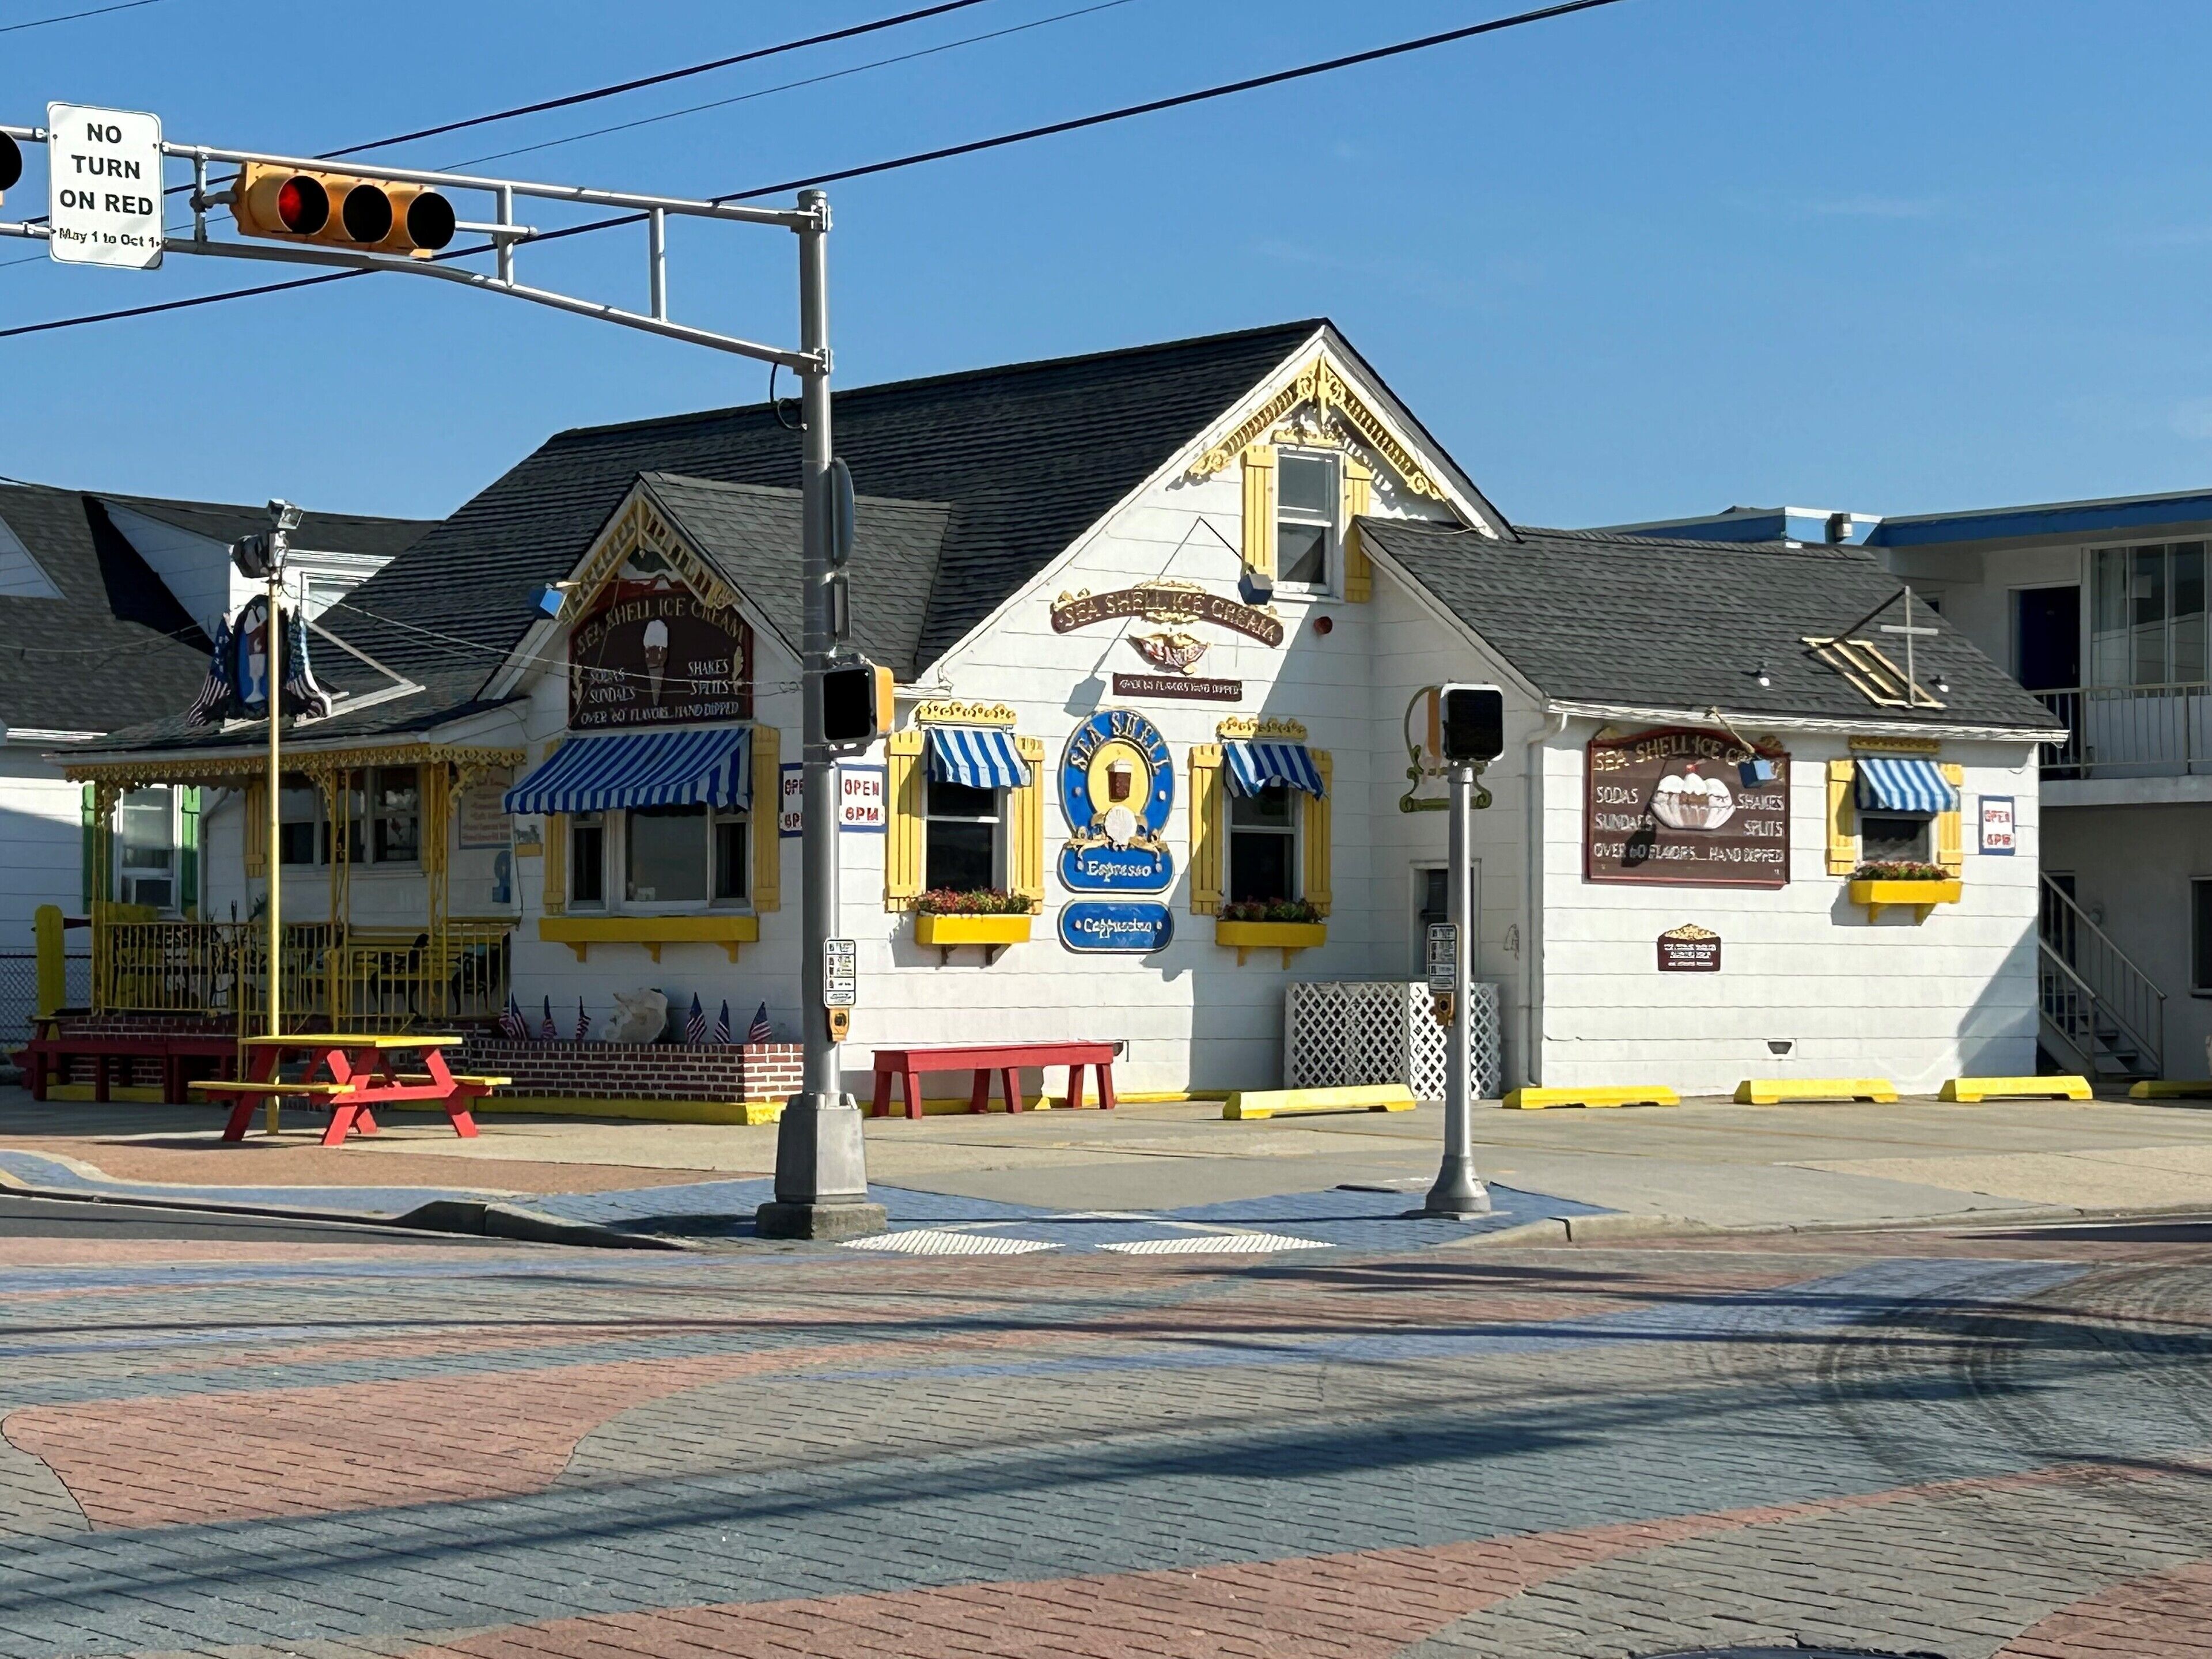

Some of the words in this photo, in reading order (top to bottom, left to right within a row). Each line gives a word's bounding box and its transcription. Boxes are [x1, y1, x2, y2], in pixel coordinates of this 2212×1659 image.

[87, 123, 122, 143] NO
[71, 154, 141, 180] TURN
[59, 190, 95, 210] ON
[105, 194, 153, 215] RED
[59, 228, 88, 244] May
[92, 231, 98, 243] 1
[104, 233, 117, 244] to
[121, 234, 144, 247] Oct
[659, 597, 686, 616] ICE
[1065, 600, 1101, 627] SEA
[1106, 591, 1167, 614] SHELL
[1173, 593, 1205, 614] ICE
[1211, 599, 1274, 642] CREAM
[687, 658, 729, 676] SHAKES
[1070, 724, 1106, 771] SEA
[1111, 711, 1171, 775] SHELL
[1593, 750, 1630, 771] SEA
[1636, 734, 1691, 763] SHELL
[1694, 736, 1724, 760] ICE
[844, 779, 879, 796] OPEN
[1596, 786, 1639, 804] SODAS
[1736, 793, 1785, 811] SHAKES
[1595, 813, 1654, 831] SUNDAES
[1743, 820, 1783, 836] SPLITS
[1594, 843, 1626, 858] OVER
[1629, 844, 1646, 858] 60
[1709, 846, 1741, 862] HAND
[1743, 847, 1784, 863] DIPPED
[1086, 861, 1152, 882] Espresso
